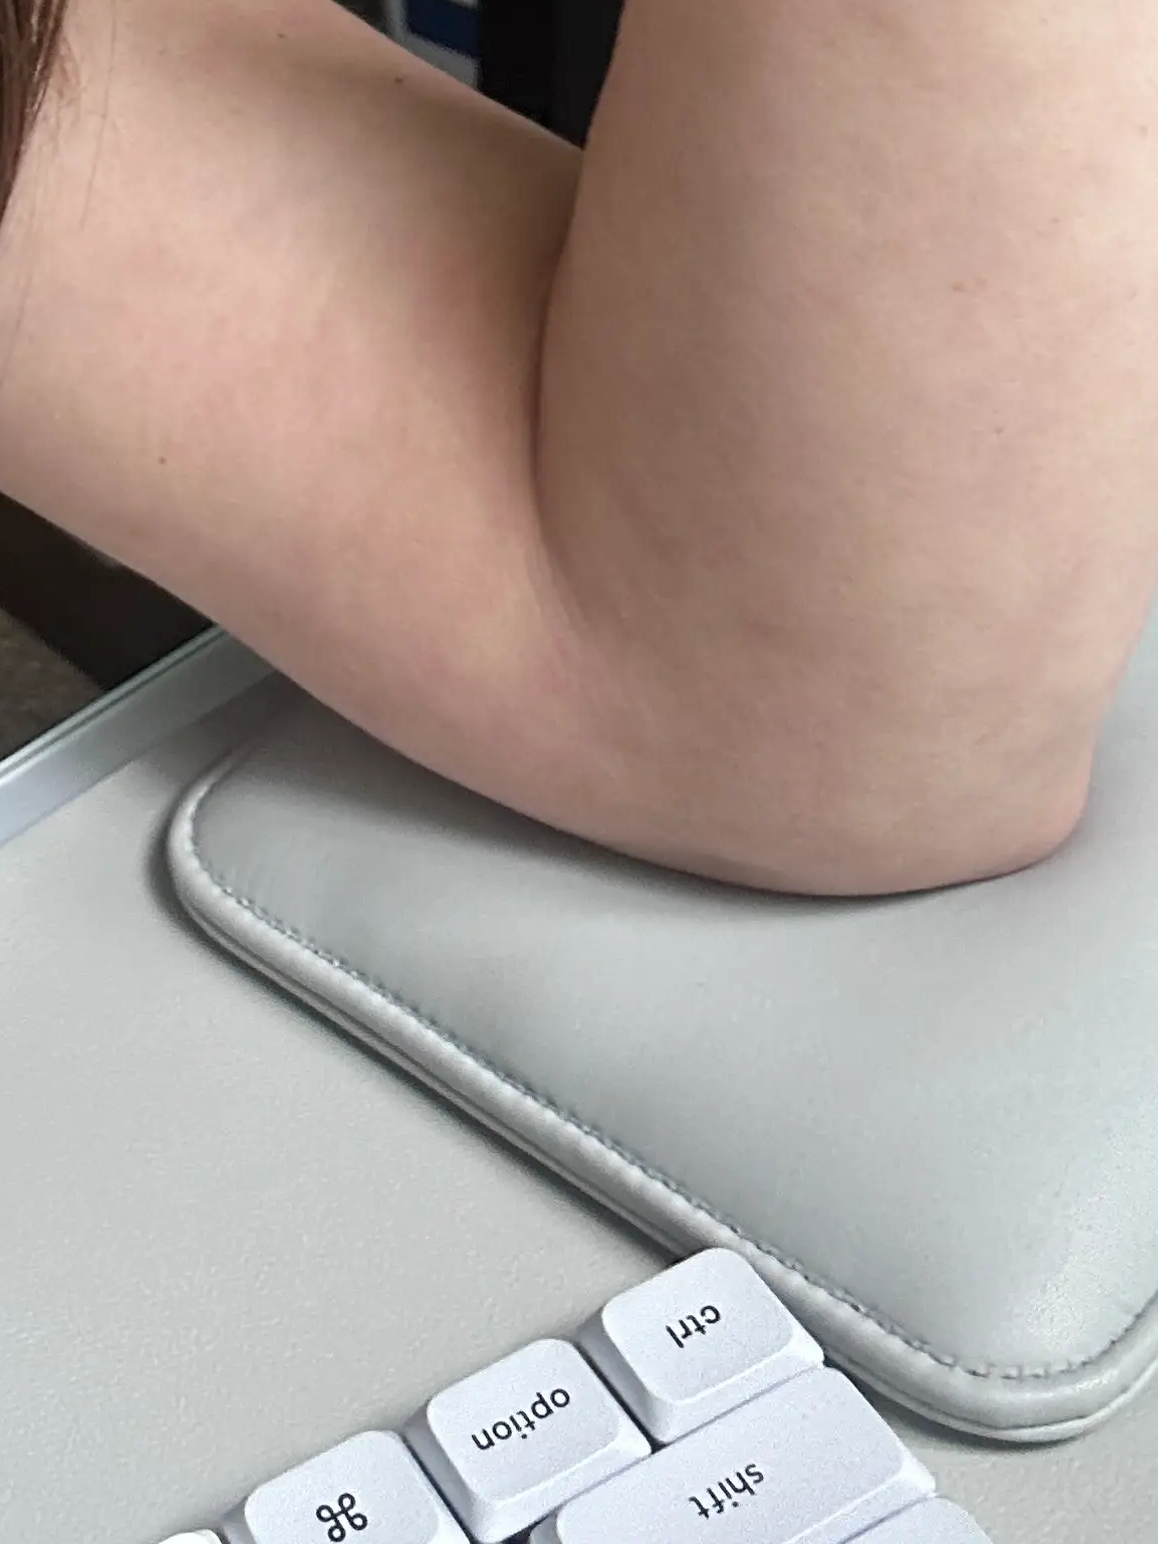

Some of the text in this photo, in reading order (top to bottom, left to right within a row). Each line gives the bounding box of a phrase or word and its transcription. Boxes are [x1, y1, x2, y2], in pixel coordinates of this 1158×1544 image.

[665, 1304, 722, 1349] ctrl
[471, 1387, 571, 1451] option
[688, 1463, 765, 1520] shift
